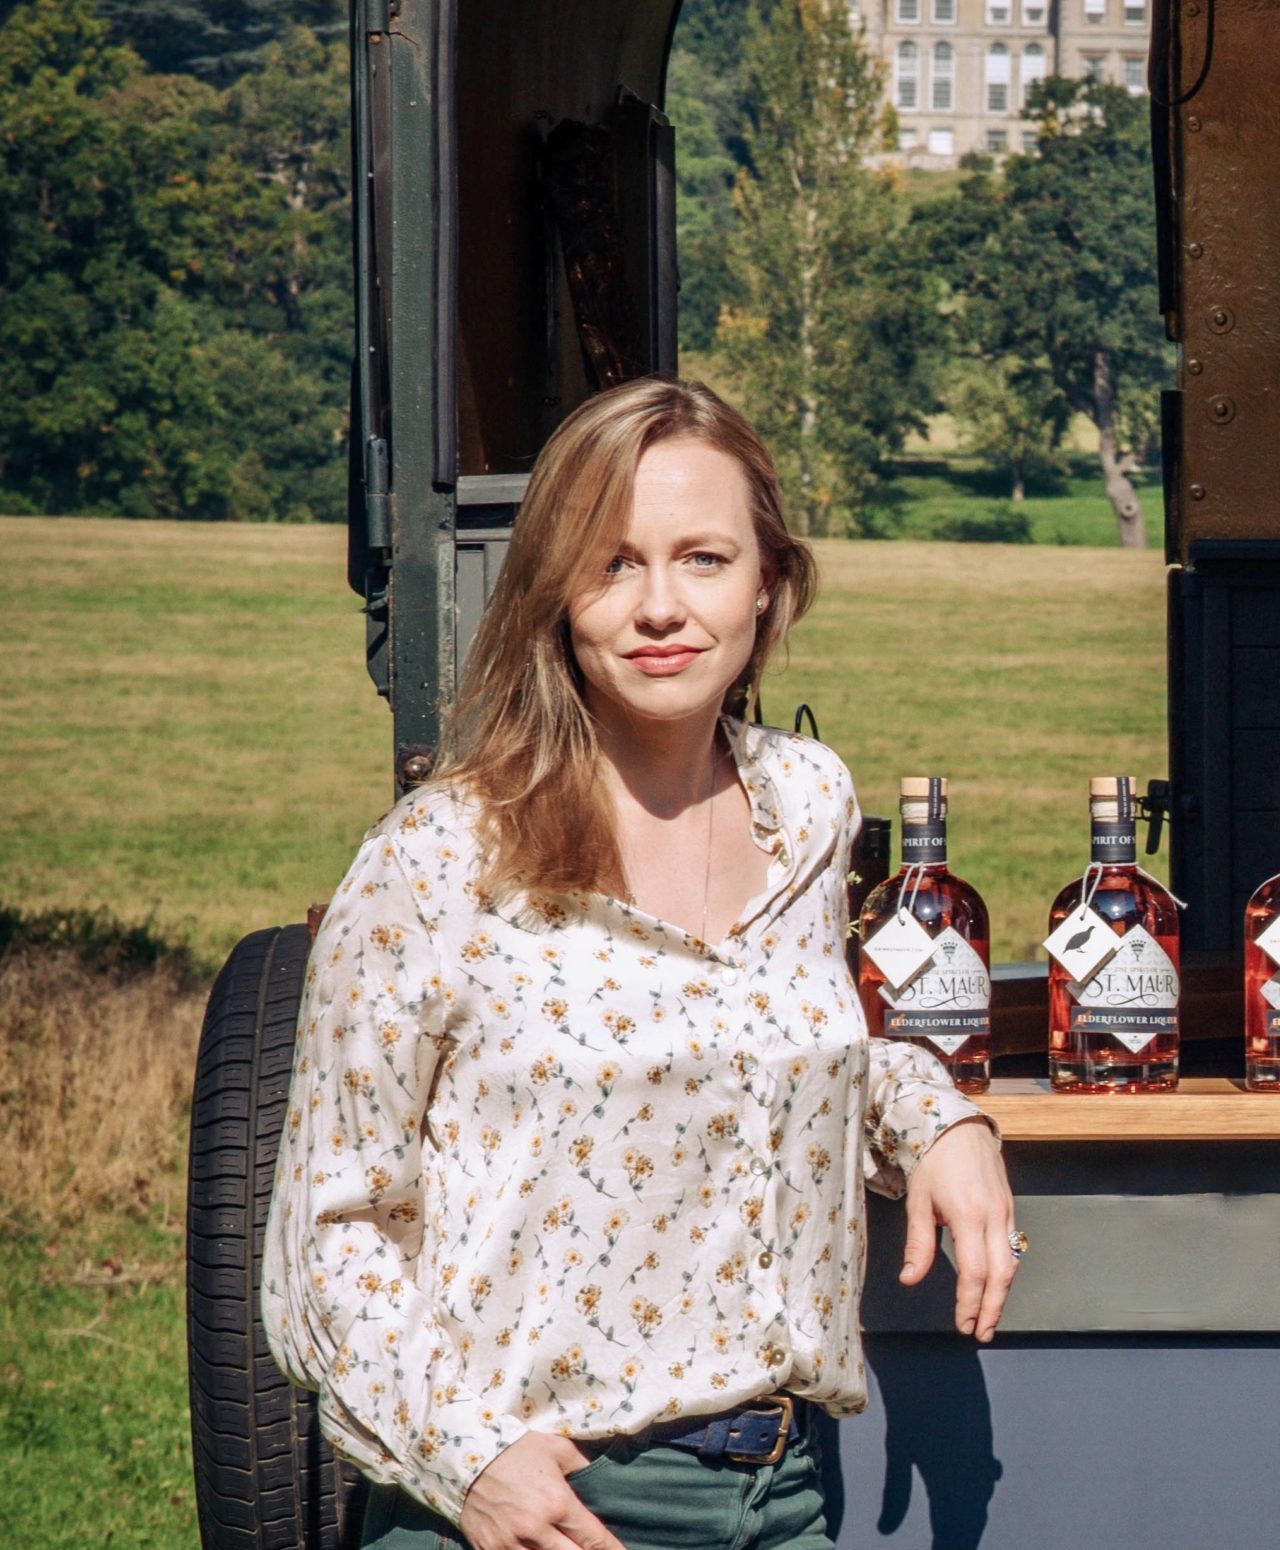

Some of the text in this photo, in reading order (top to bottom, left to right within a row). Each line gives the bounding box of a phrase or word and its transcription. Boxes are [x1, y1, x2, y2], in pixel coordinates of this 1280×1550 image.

[903, 837, 930, 847] PIRIT
[1092, 836, 1118, 845] PIRIT
[1119, 835, 1132, 845] OF
[939, 976, 989, 1000] MAUR
[1126, 974, 1177, 999] MAUR
[890, 1017, 961, 1028] ELDERFLOWER
[1077, 1015, 1148, 1026] ELDERFLOWER
